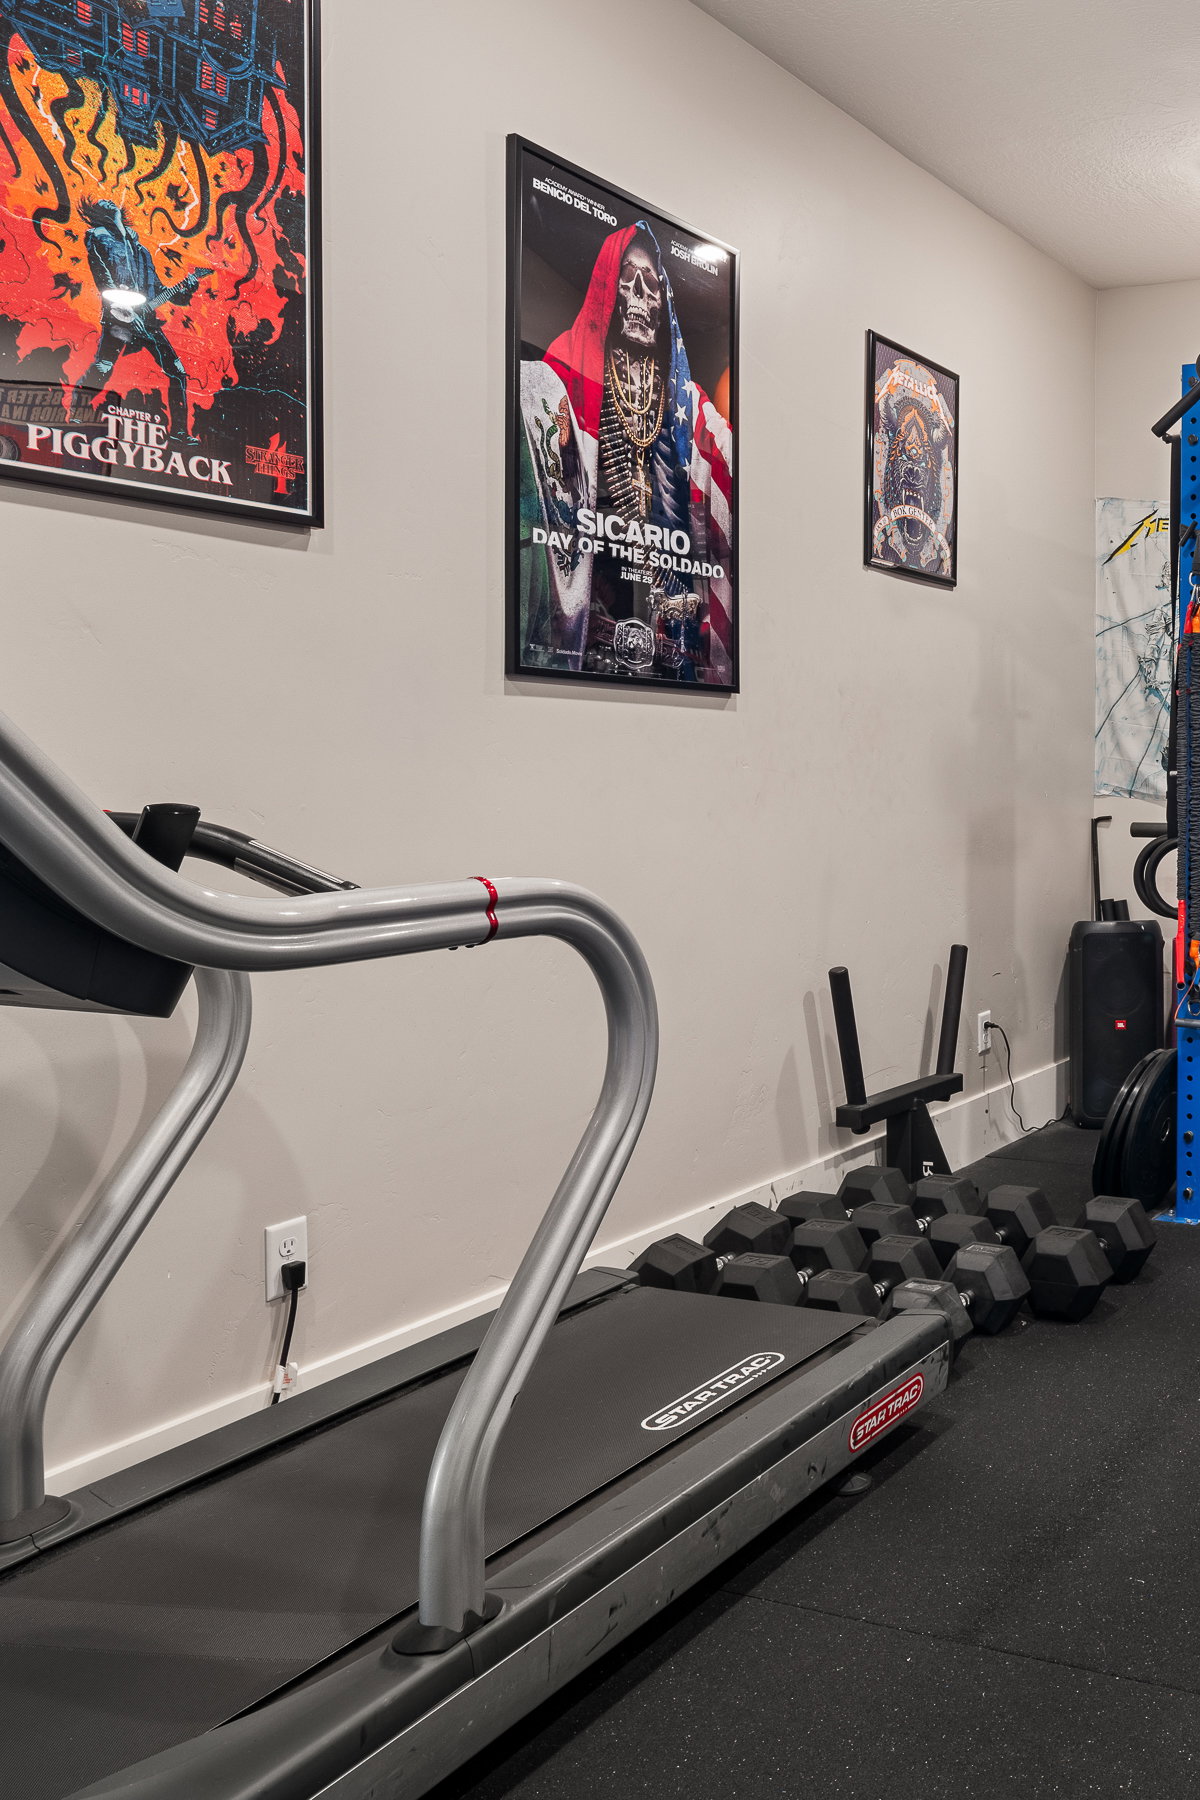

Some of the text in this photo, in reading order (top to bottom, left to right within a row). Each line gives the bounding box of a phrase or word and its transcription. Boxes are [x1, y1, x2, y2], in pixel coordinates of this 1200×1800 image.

[532, 177, 618, 227] BENICIO DEL TORO
[671, 245, 690, 263] JOSH
[690, 254, 719, 276] BROLIN
[107, 404, 161, 424] CHAPTER 9
[875, 365, 953, 437] METALLICA
[101, 412, 169, 450] THE
[26, 423, 233, 486] PIGGYBACK
[245, 446, 304, 473] STRANGER
[254, 461, 296, 480] THINGS
[576, 508, 691, 555] SICARIO
[532, 527, 724, 579] DAY OF THE SOLDADO
[628, 567, 653, 577] THEATERS
[620, 571, 653, 584] JUNE 29
[655, 1356, 770, 1426] STAR TRAC
[855, 1384, 918, 1441] STAR TRAC
